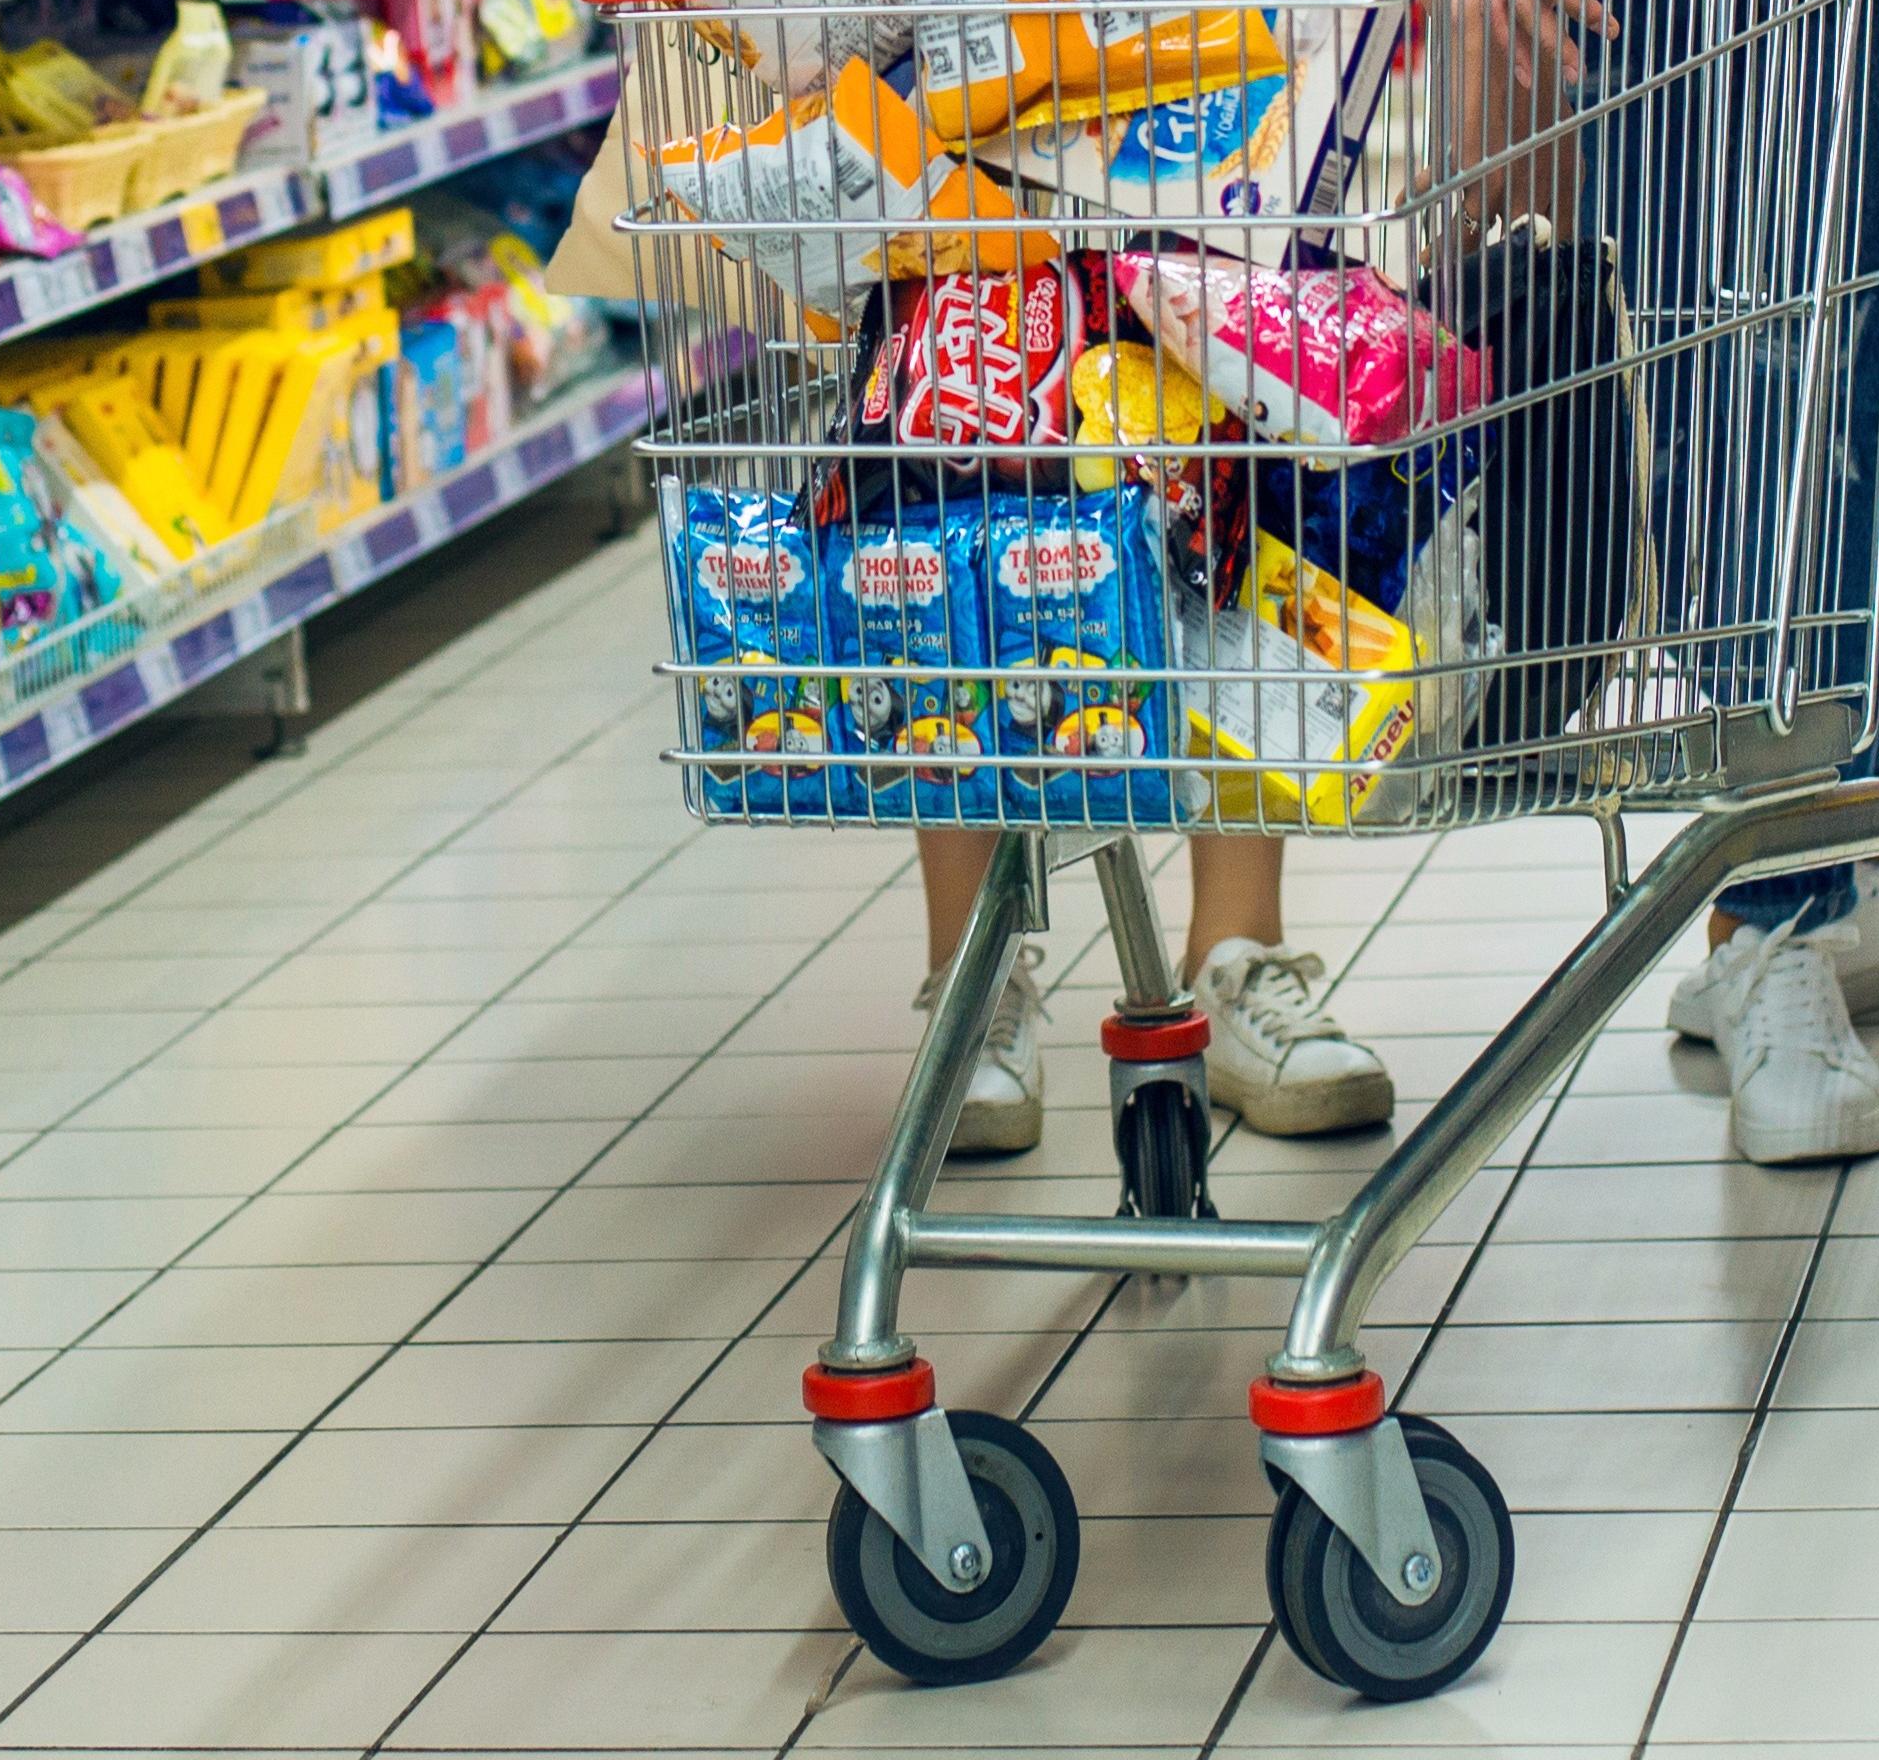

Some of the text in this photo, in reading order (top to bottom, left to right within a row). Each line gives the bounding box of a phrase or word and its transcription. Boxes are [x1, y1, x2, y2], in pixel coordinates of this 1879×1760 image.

[704, 553, 792, 575] THOMAS
[856, 556, 940, 577] THOAS
[716, 575, 727, 588] &
[1016, 571, 1028, 586] &
[861, 581, 870, 593] &
